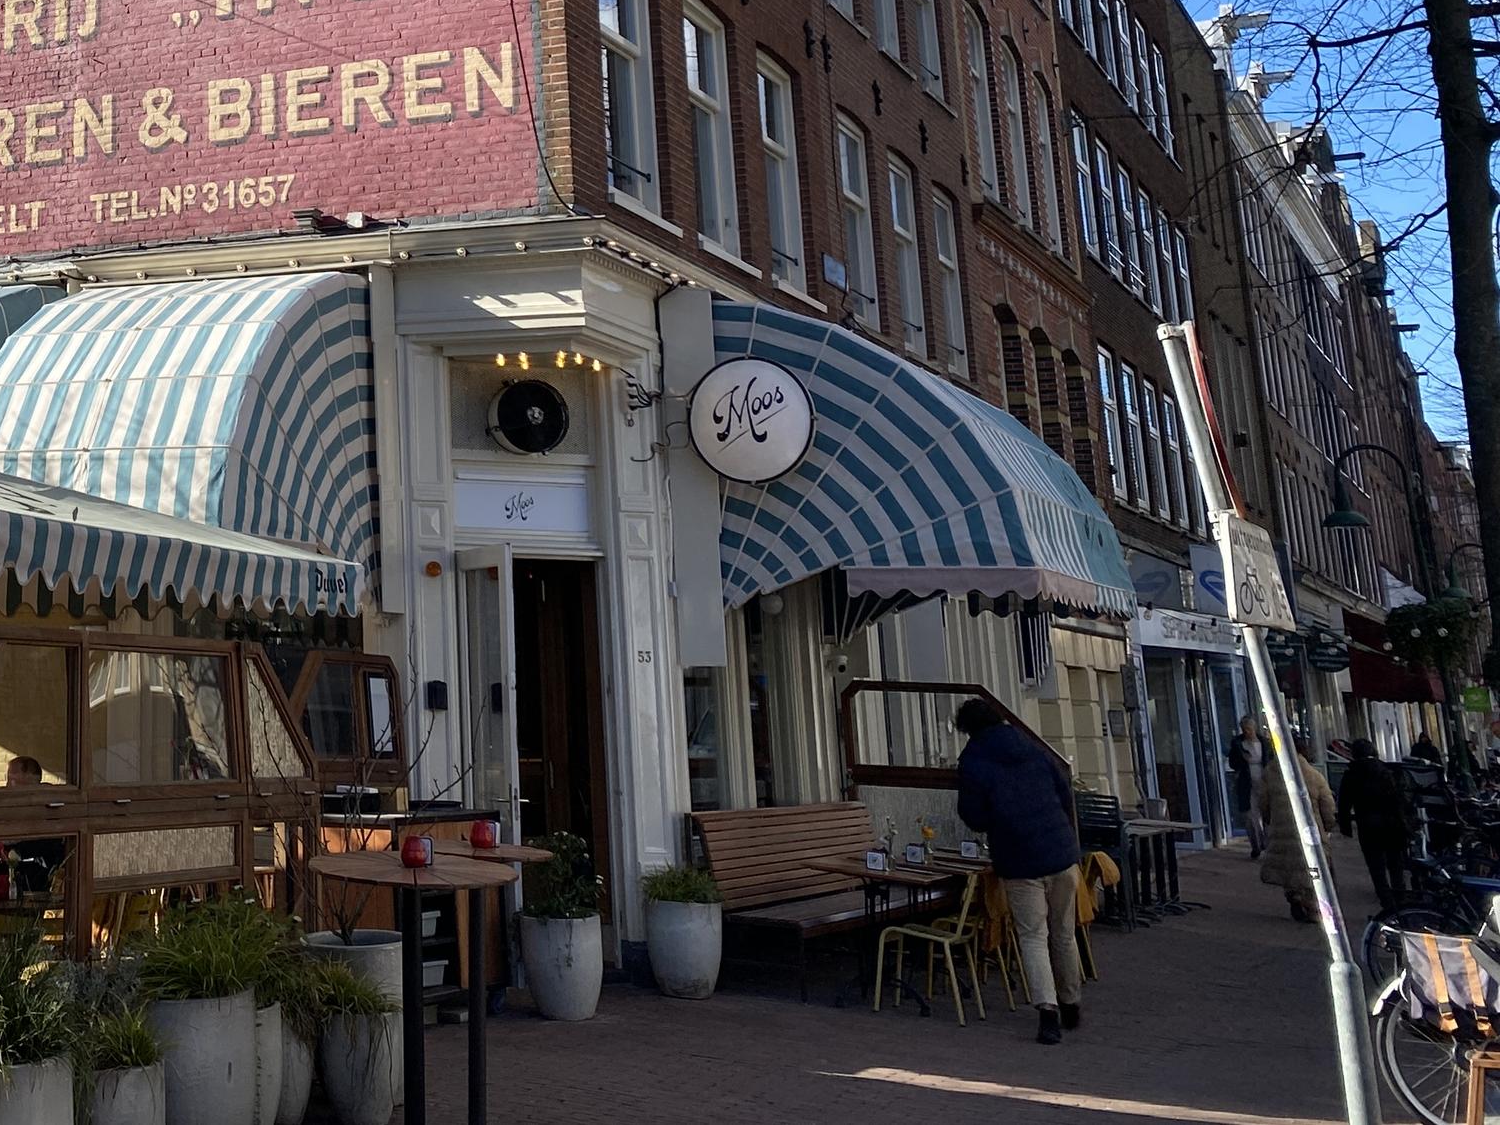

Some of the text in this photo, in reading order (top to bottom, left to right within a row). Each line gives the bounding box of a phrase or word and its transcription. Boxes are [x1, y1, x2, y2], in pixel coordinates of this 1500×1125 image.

[138, 87, 189, 149] &
[208, 42, 514, 143] BIEREN
[712, 376, 785, 444] Moos
[504, 491, 534, 521] Moos
[315, 567, 348, 593] Duvel
[637, 650, 652, 663] 53
